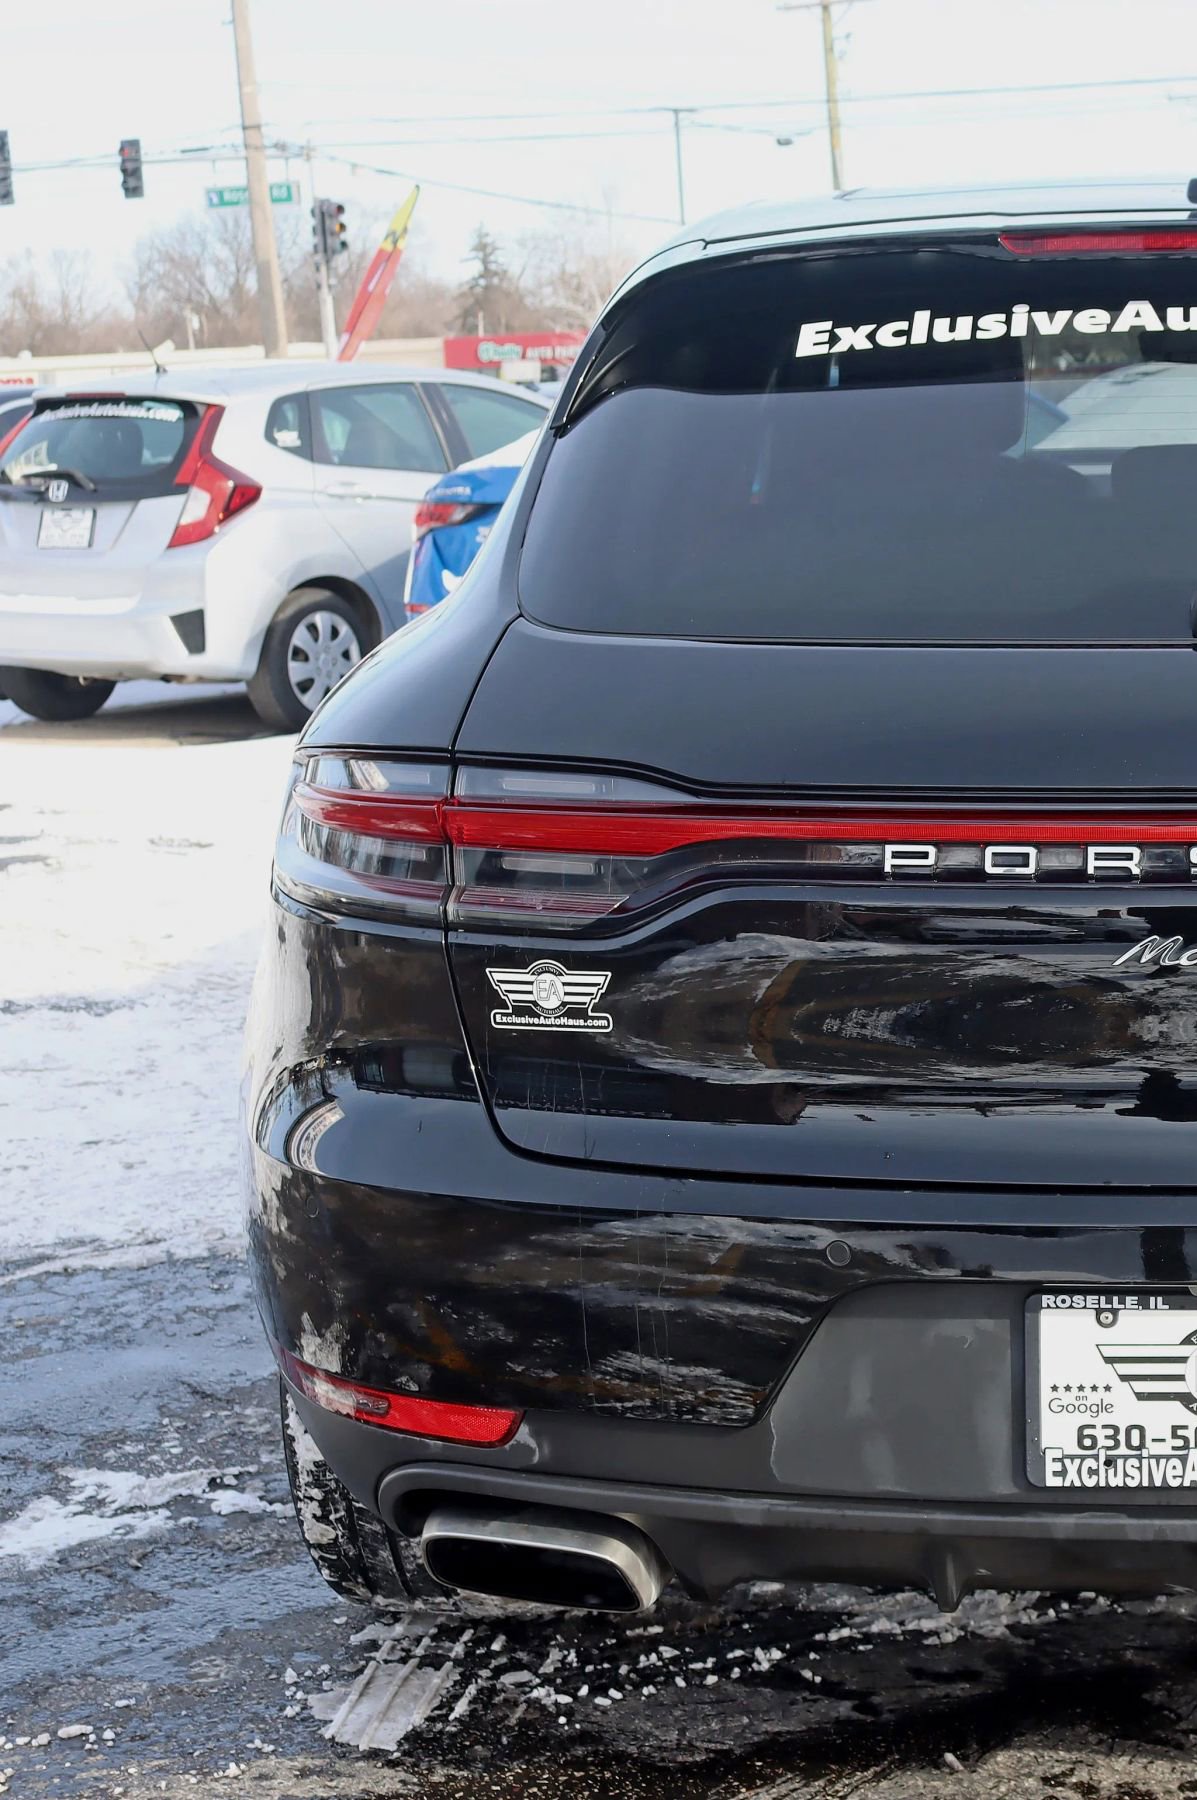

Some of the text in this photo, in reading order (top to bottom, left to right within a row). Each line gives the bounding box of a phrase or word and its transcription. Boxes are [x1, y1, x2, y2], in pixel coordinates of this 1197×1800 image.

[495, 1013, 608, 1027] ExclusiveAutoHaus.com
[1041, 1294, 1170, 1311] ROSELLE, IL
[1048, 1397, 1115, 1419] Google
